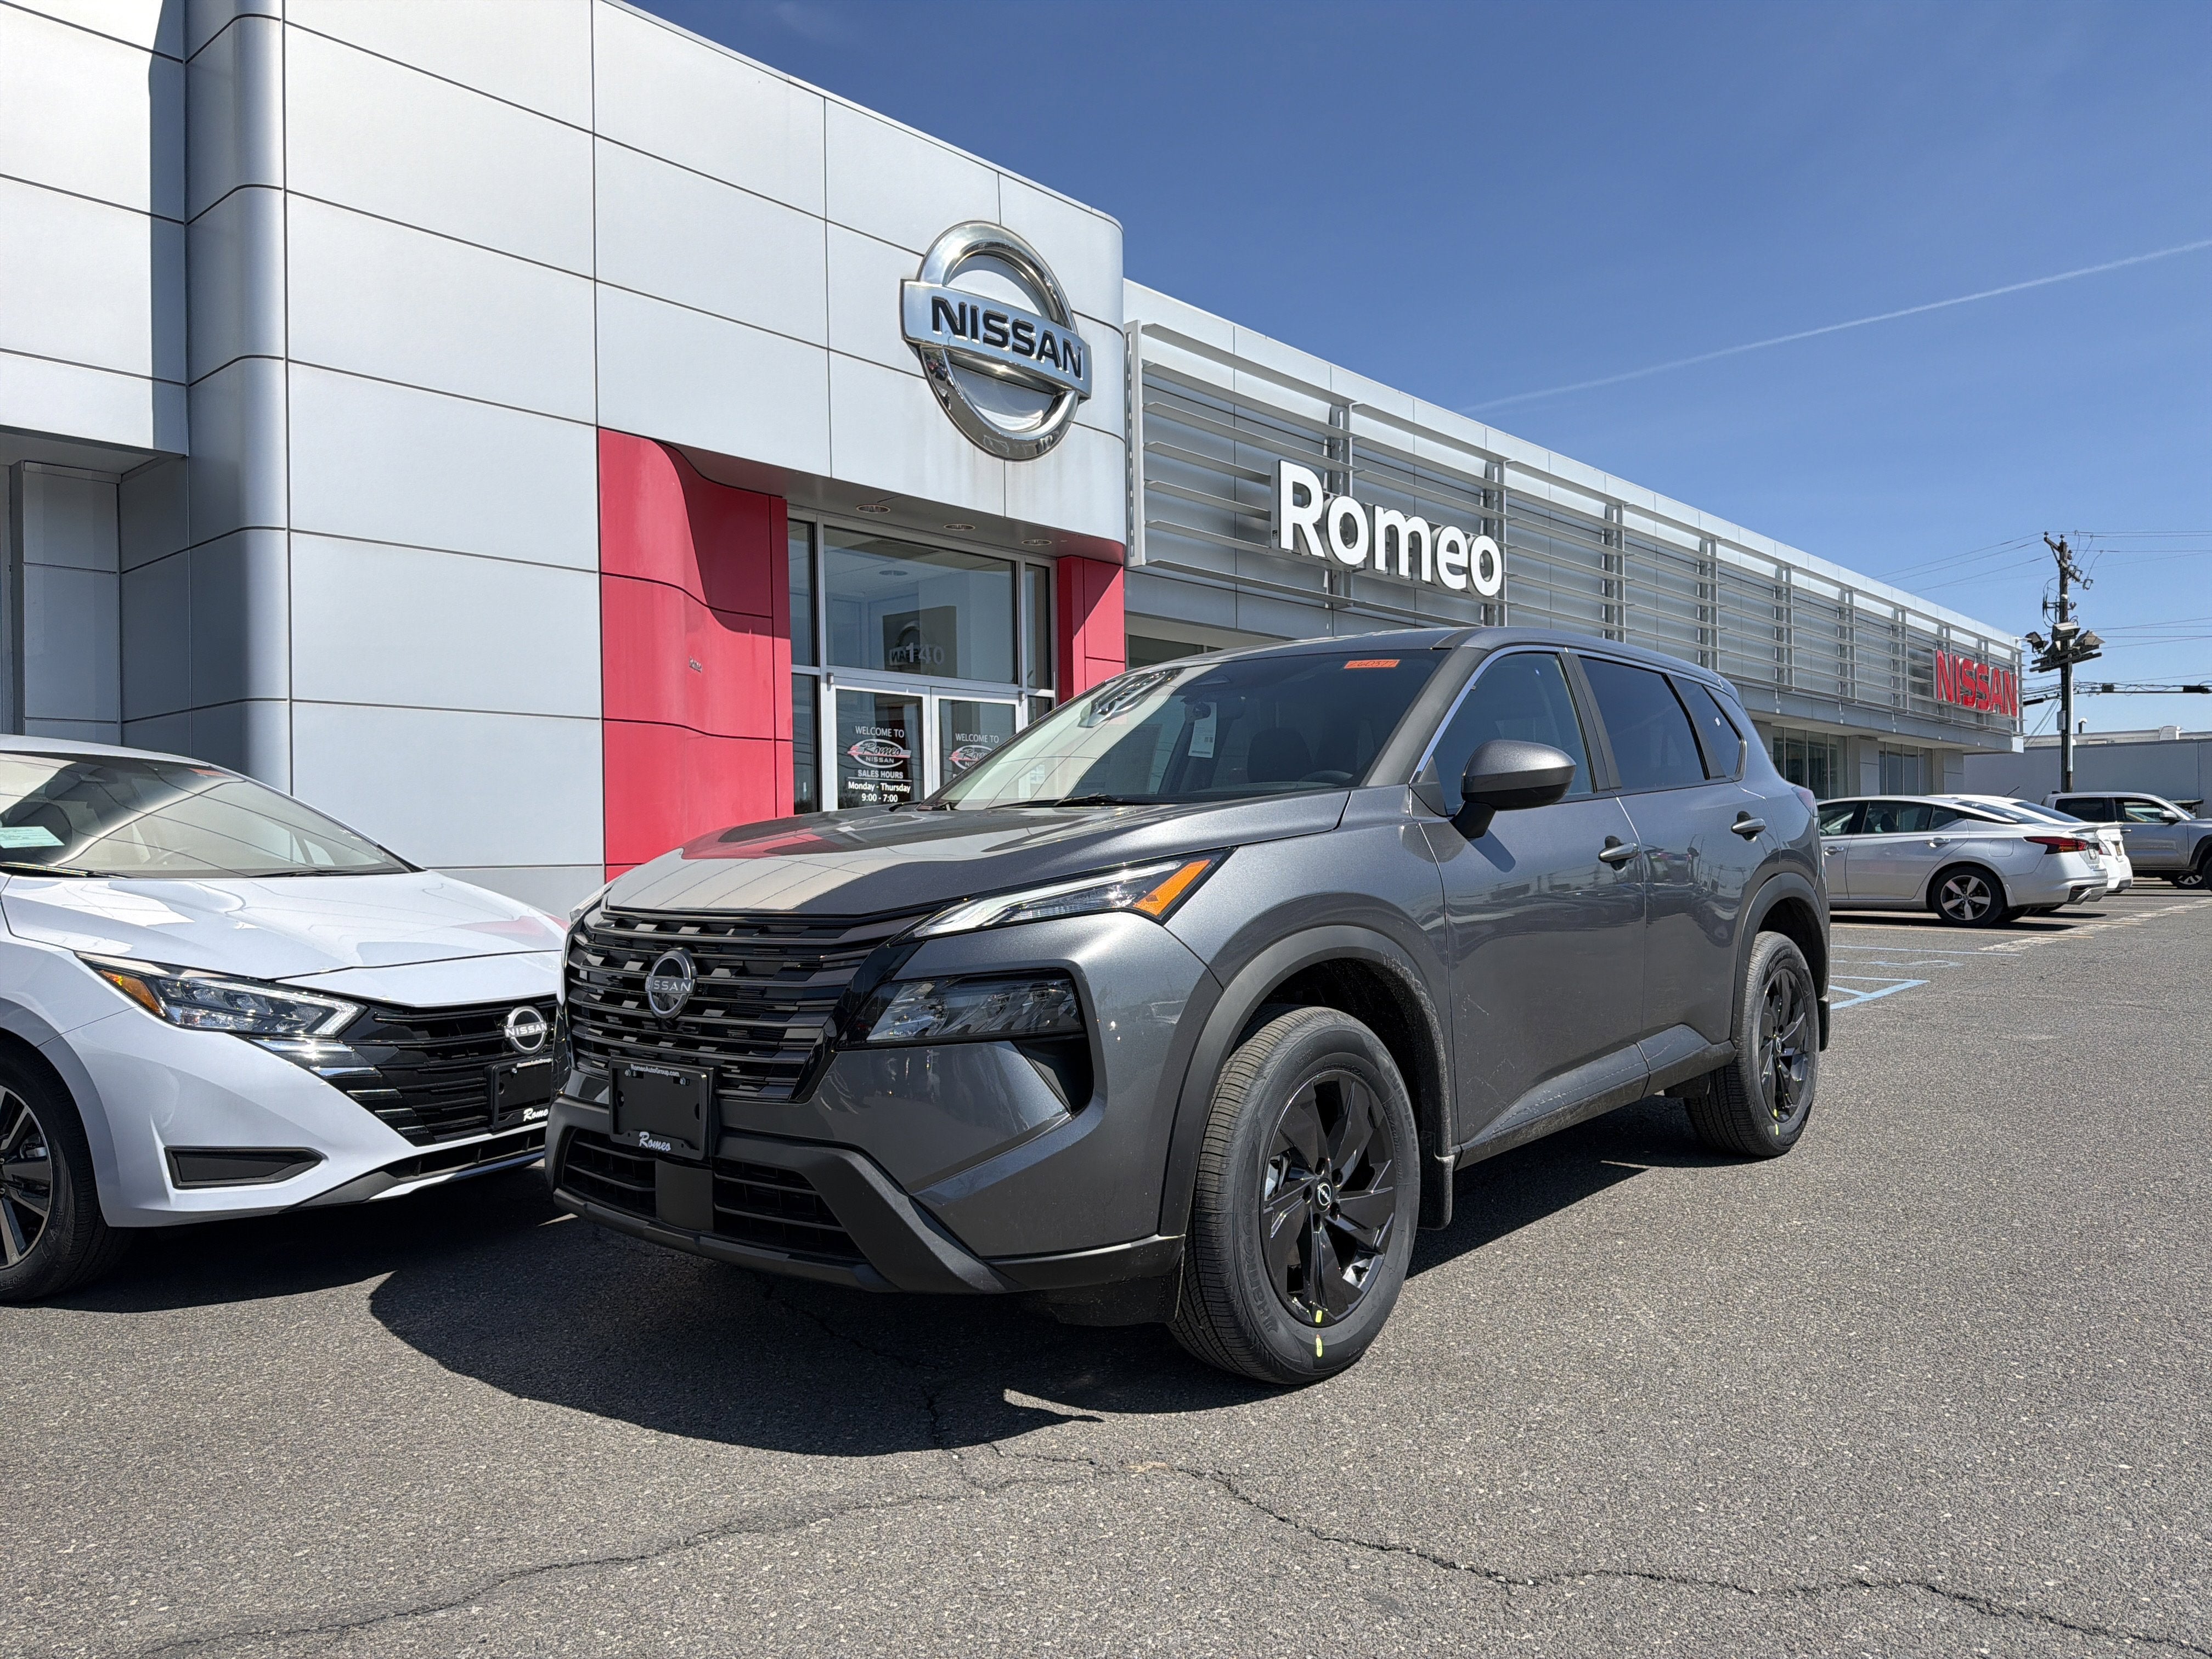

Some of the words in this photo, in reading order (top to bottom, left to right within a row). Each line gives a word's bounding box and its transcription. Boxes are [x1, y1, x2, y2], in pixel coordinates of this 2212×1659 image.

[931, 295, 1084, 381] NISSAN
[1277, 459, 1503, 597] Romeo
[905, 642, 945, 665] 140
[1934, 649, 2018, 718] NISSAN
[855, 726, 893, 737] WELCOME
[893, 729, 905, 738] TO
[955, 733, 988, 743] WELCOME
[990, 735, 999, 743] TO
[862, 741, 901, 756] Romeo
[961, 747, 988, 760] Rom
[857, 769, 879, 778] SALES
[881, 770, 904, 779] HOURS
[848, 781, 876, 792] Monday
[880, 782, 911, 794] Thursday
[861, 793, 877, 802] 9:00
[883, 794, 898, 803] 7:00
[505, 1022, 547, 1037] NISSAN
[630, 1063, 680, 1077] RomeoAutoGroup.com
[522, 1108, 549, 1122] Rome
[639, 1131, 672, 1152] Romeo
